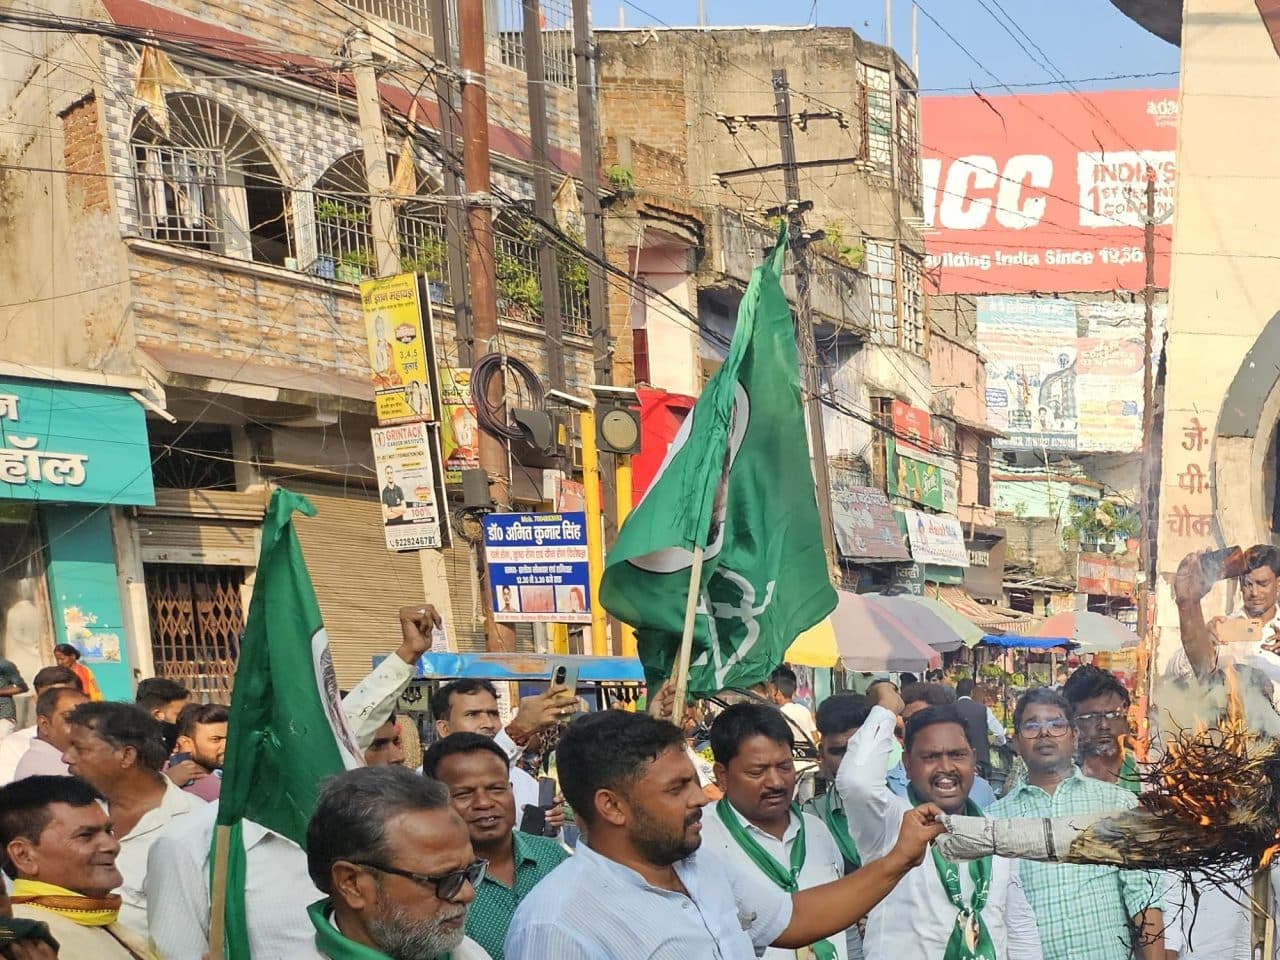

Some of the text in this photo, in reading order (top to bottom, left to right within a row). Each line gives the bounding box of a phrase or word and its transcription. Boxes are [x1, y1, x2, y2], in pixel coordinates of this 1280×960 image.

[995, 251, 1040, 265] India
[1045, 249, 1094, 265] Since
[386, 426, 423, 441] GRINTACK
[506, 521, 532, 541] अमित
[533, 525, 561, 545] कुमार
[562, 520, 581, 540] सिंह
